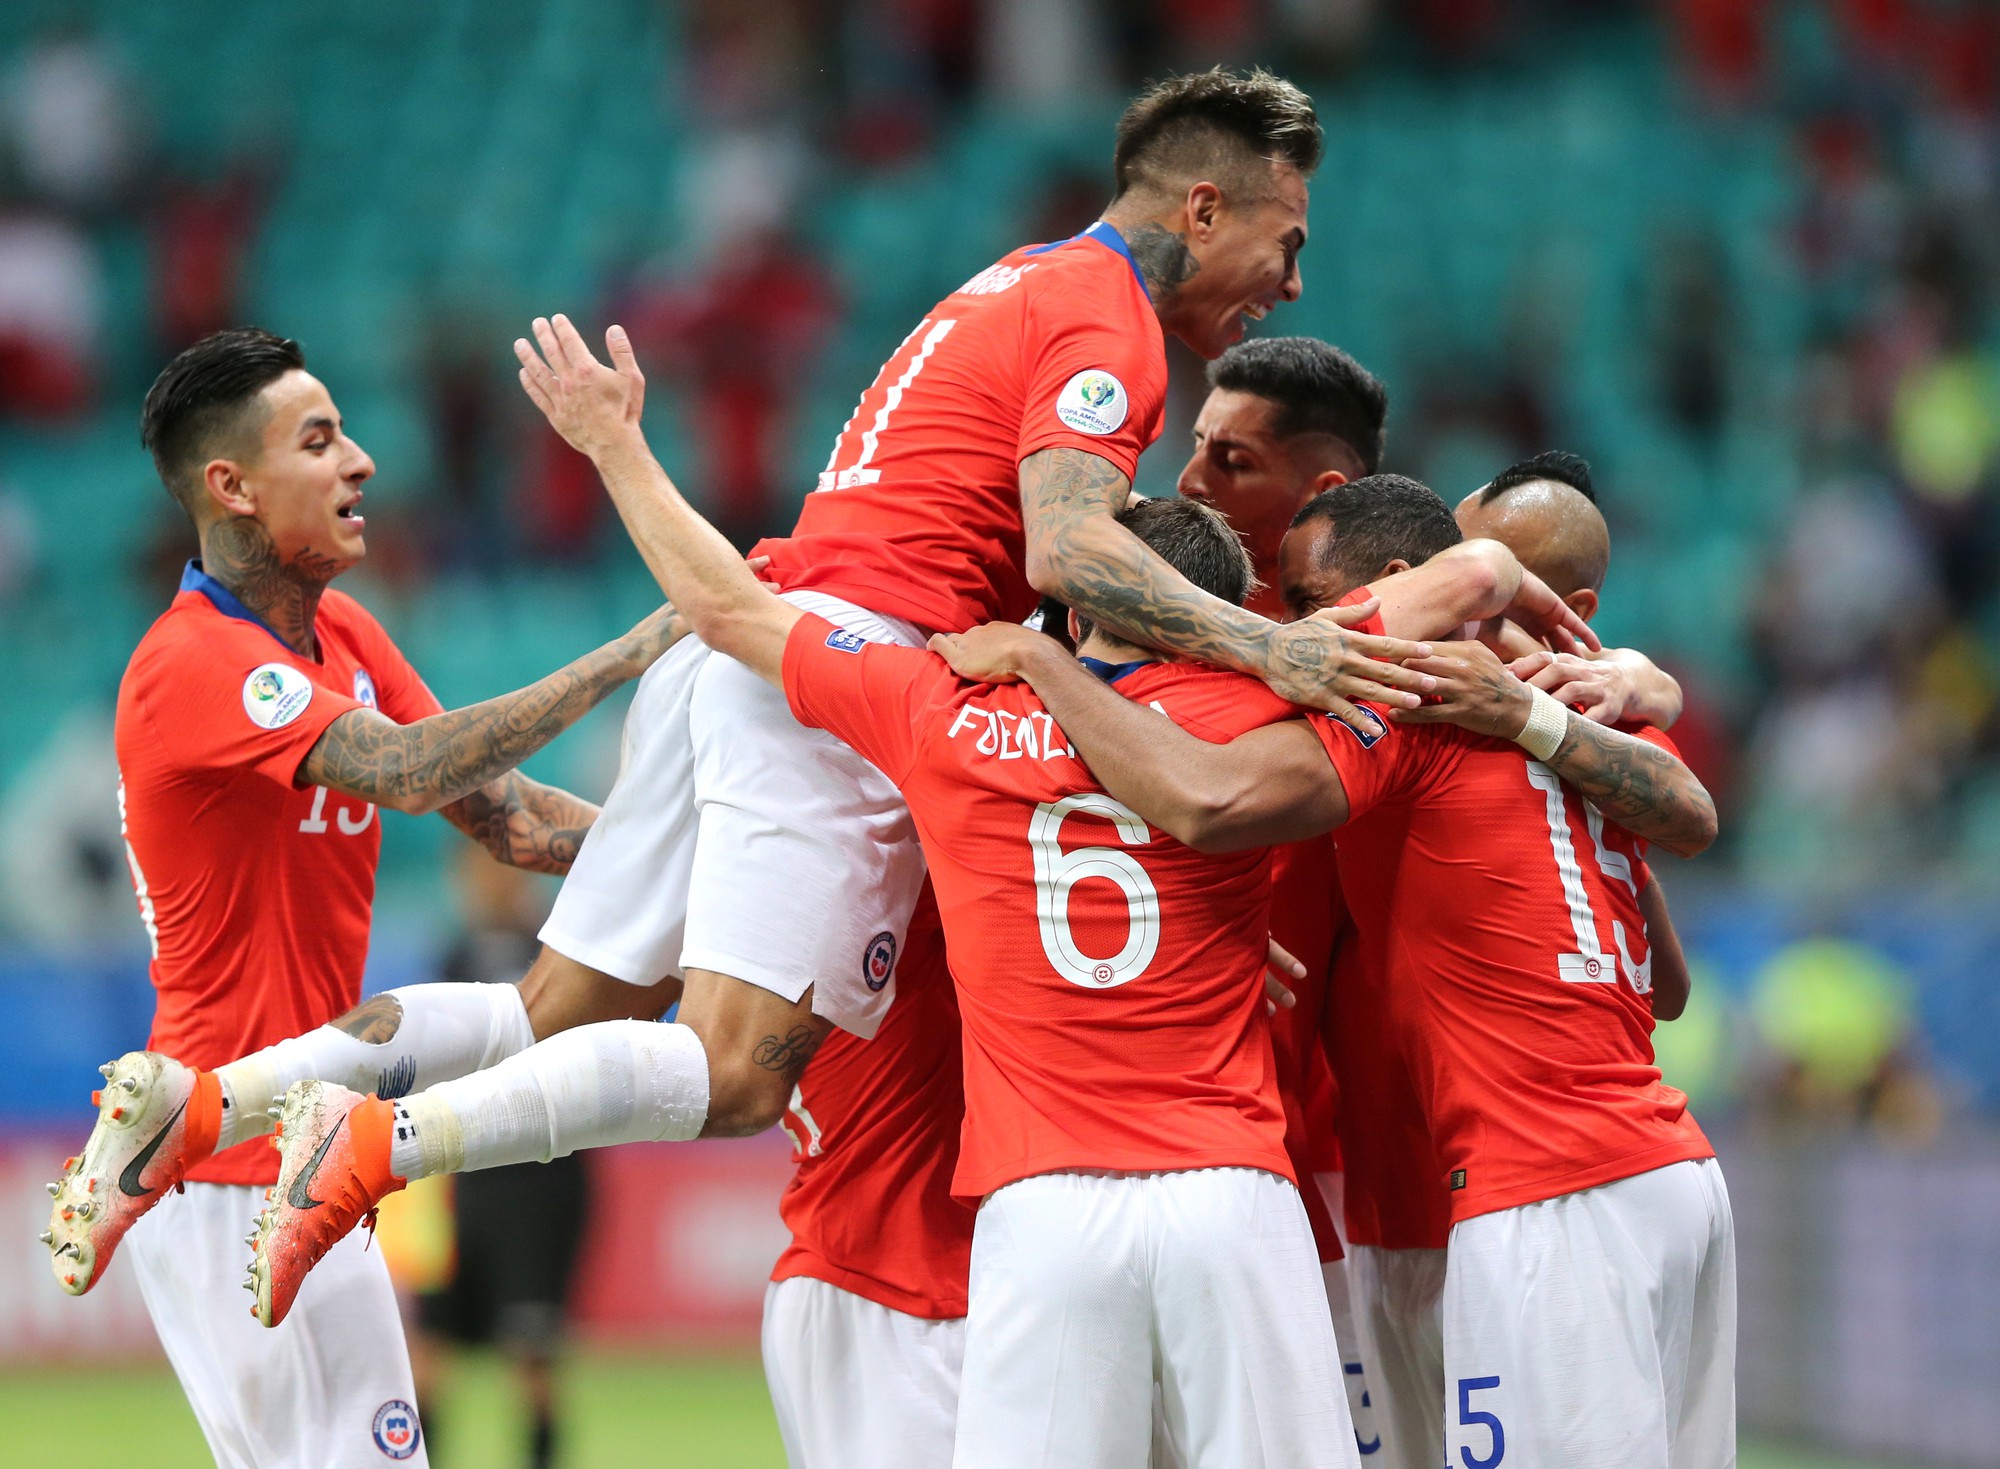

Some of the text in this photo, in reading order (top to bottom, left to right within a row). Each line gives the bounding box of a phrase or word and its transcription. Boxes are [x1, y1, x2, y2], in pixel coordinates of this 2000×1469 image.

[815, 318, 957, 492] 11
[1059, 407, 1078, 416] COPA
[1080, 412, 1111, 430] AMERICA
[1027, 793, 1161, 990] 6
[1525, 760, 1652, 995] 15
[1444, 1375, 1505, 1469] 5
